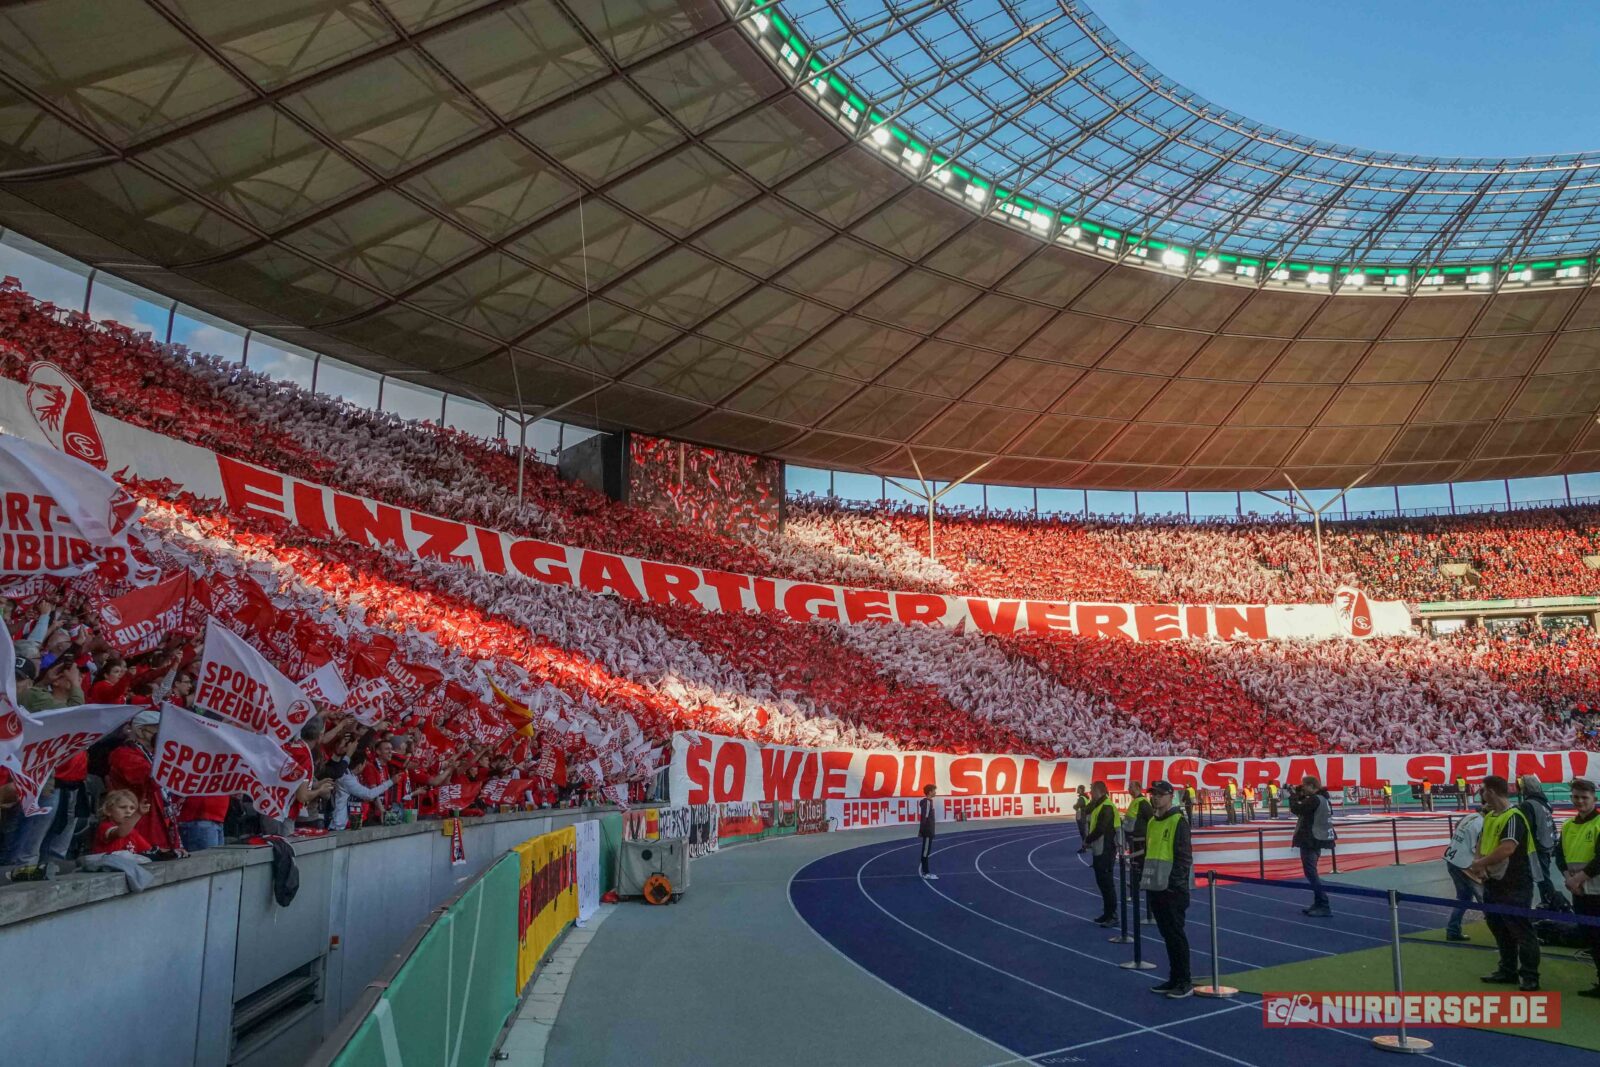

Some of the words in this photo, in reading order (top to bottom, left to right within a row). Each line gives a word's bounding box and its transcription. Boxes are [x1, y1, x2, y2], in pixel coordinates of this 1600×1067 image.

[216, 453, 948, 627] EINZIGARTIGER
[966, 599, 1268, 640] VEREIN
[686, 736, 747, 805] SO
[760, 748, 853, 801] WIE
[860, 753, 936, 799] DU
[949, 756, 1077, 797] SOLL
[1091, 757, 1390, 791] FUSSBALL
[1406, 750, 1588, 787] SEIN!
[843, 800, 922, 827] SPORT-CLU
[944, 797, 1023, 820] FREIBURG
